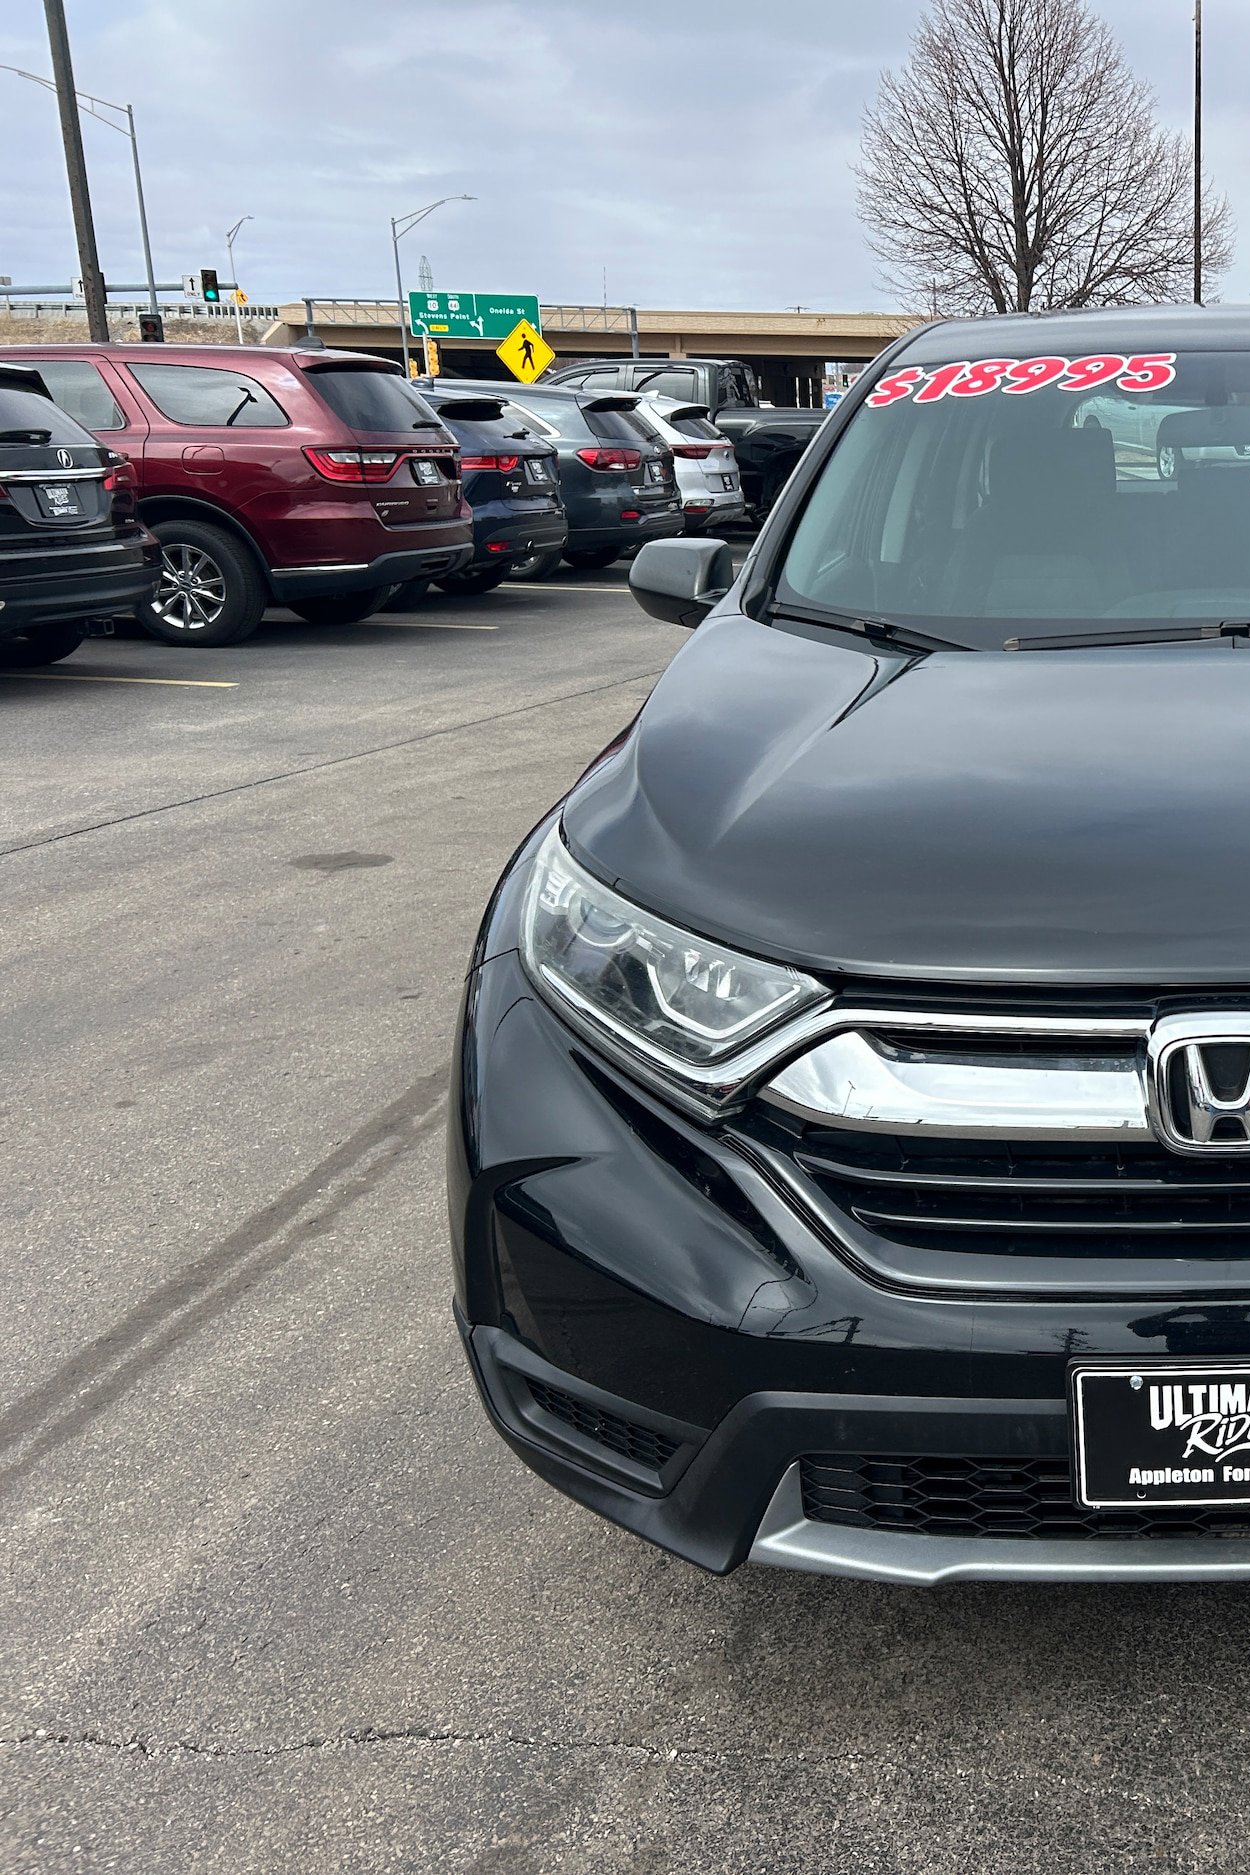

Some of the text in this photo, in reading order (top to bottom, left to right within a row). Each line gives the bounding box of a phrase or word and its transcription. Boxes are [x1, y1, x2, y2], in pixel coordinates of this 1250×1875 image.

[418, 312, 447, 320] Stevens
[489, 307, 514, 315] Oneida
[865, 352, 1177, 408] $18995
[1129, 1467, 1214, 1486] Appleton
